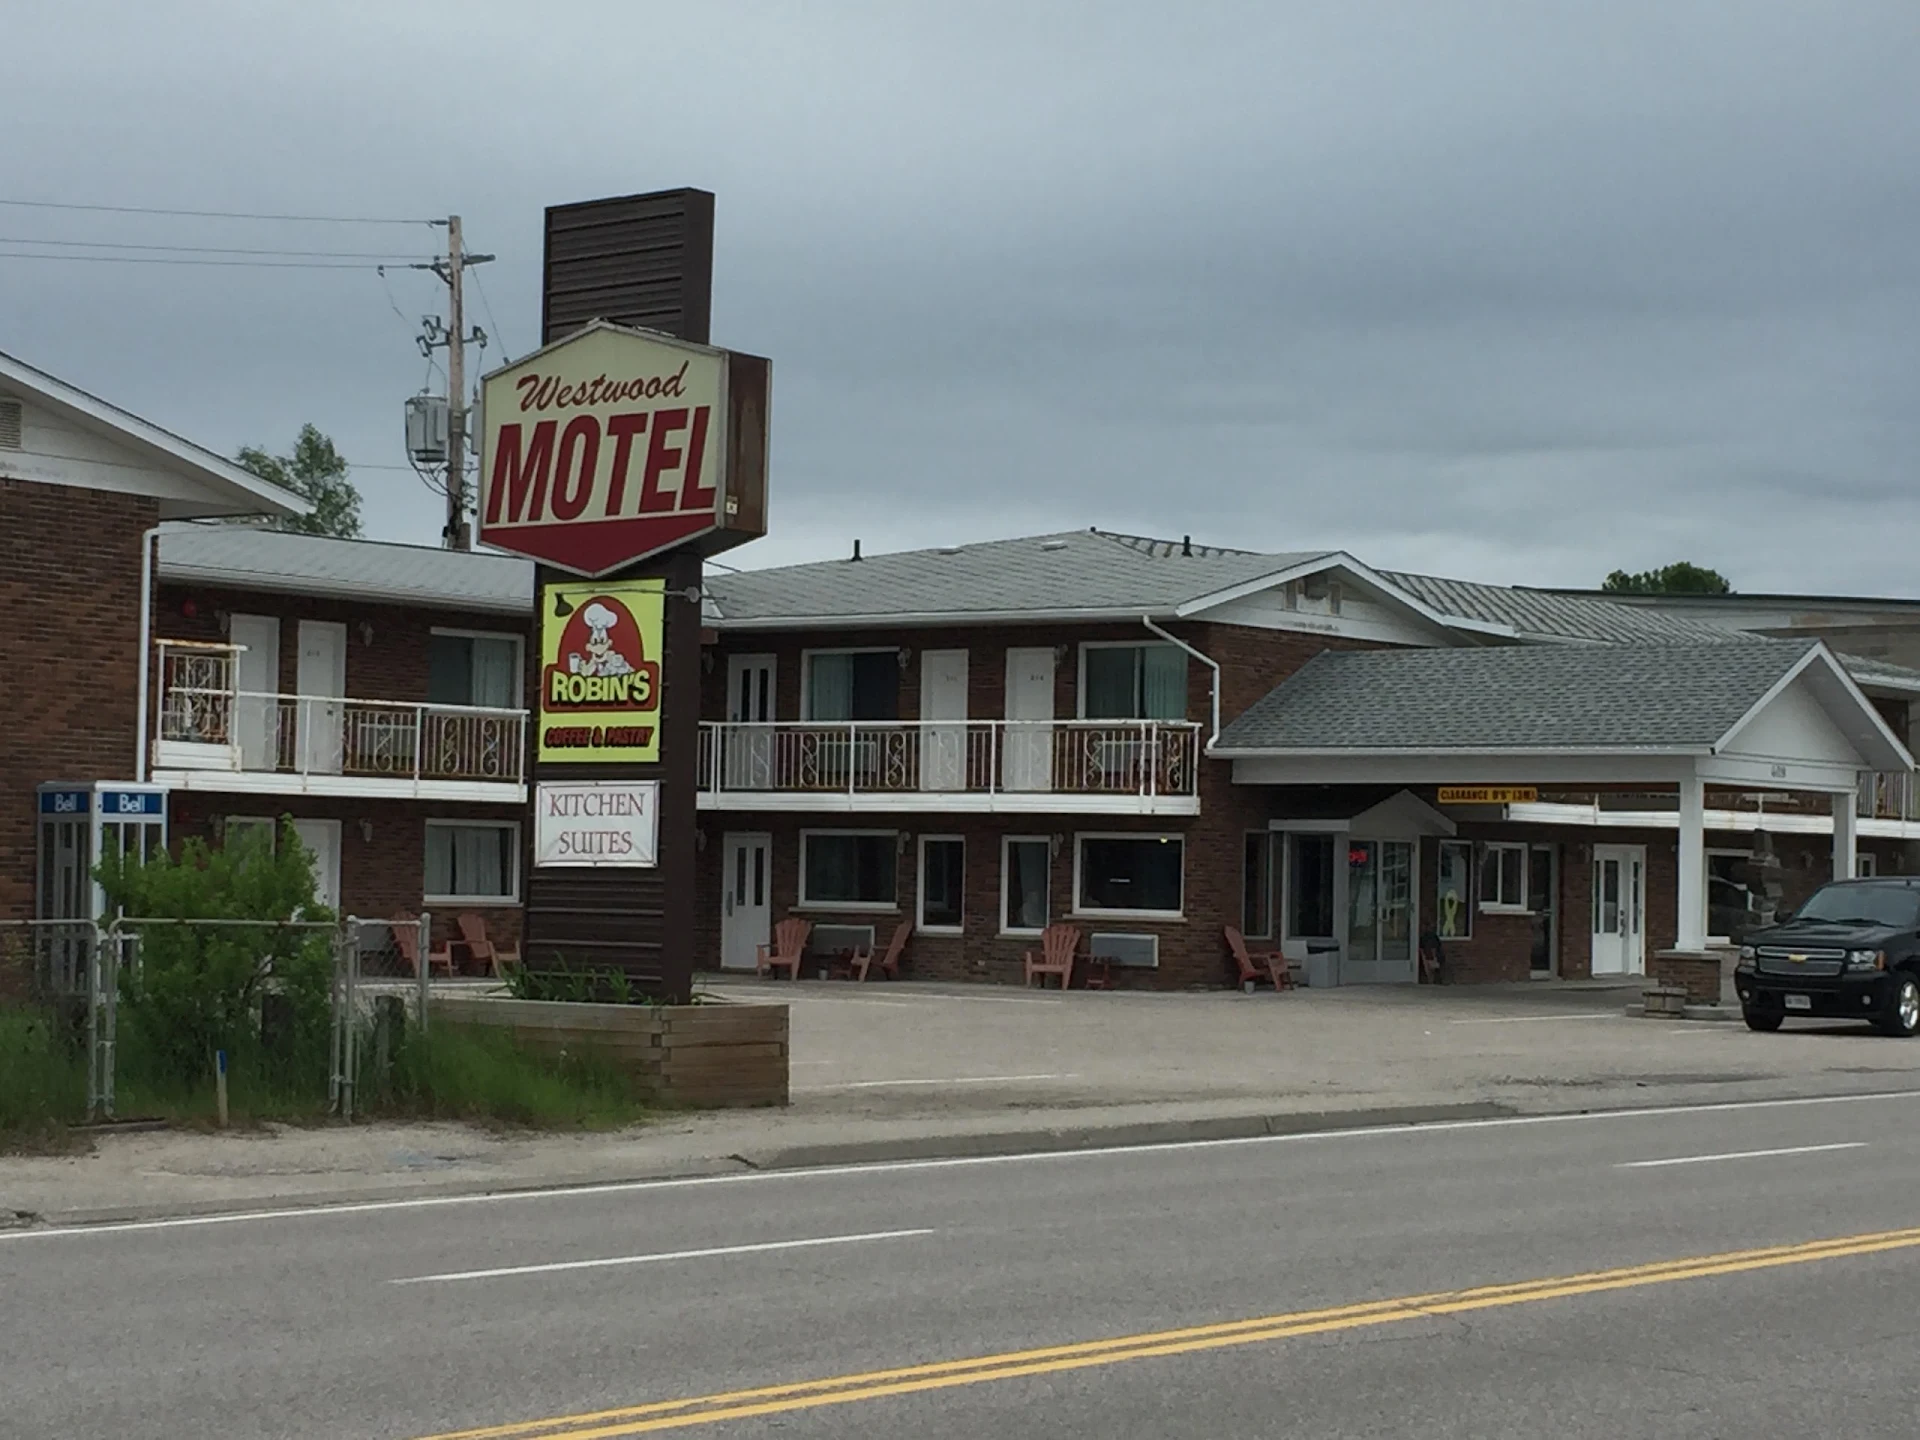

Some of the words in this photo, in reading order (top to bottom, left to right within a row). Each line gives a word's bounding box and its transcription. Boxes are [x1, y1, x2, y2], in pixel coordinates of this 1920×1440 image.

[516, 360, 690, 412] Westwood
[485, 405, 717, 525] MOTEL
[550, 669, 651, 705] ROBIN'S
[544, 727, 592, 748] COFFEE
[592, 726, 603, 747] &
[604, 726, 654, 748] PASTRY
[54, 794, 77, 812] Bell
[119, 794, 146, 812] Bell
[549, 793, 645, 817] KITCHEN
[558, 831, 633, 855] SUITES
